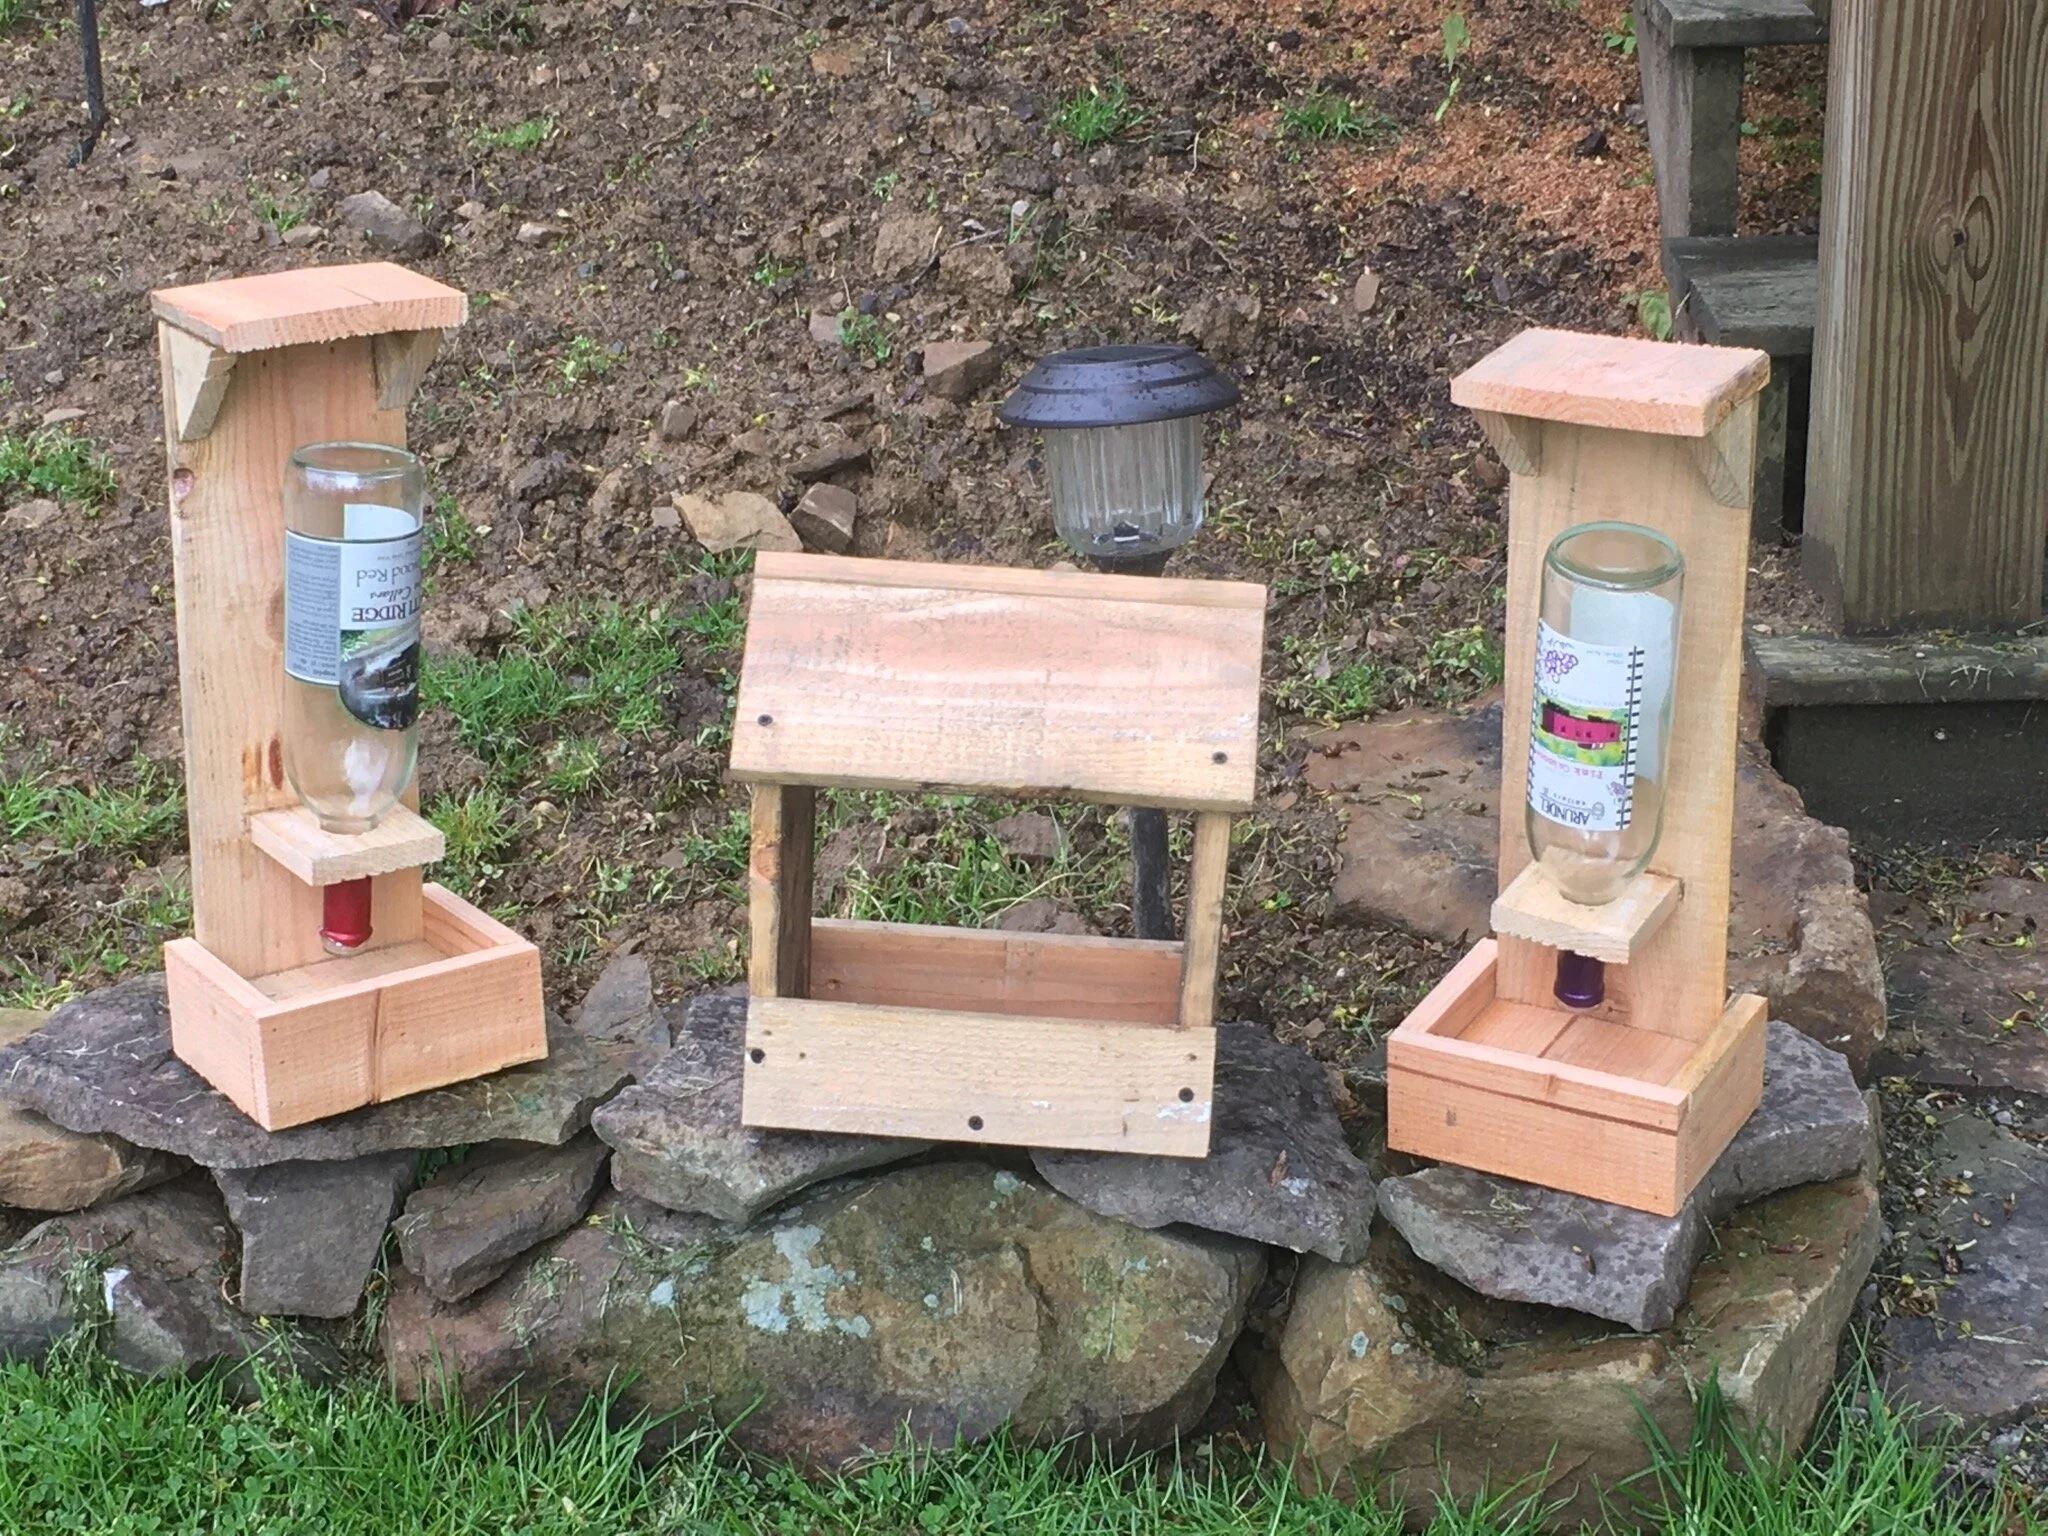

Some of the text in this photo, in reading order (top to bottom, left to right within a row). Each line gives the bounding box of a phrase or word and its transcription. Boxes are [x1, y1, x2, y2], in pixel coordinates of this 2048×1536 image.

[356, 568, 388, 588] Red
[370, 586, 412, 602] Cellars
[351, 601, 407, 622] RIDGE
[1541, 797, 1591, 826] ARUNDEL
